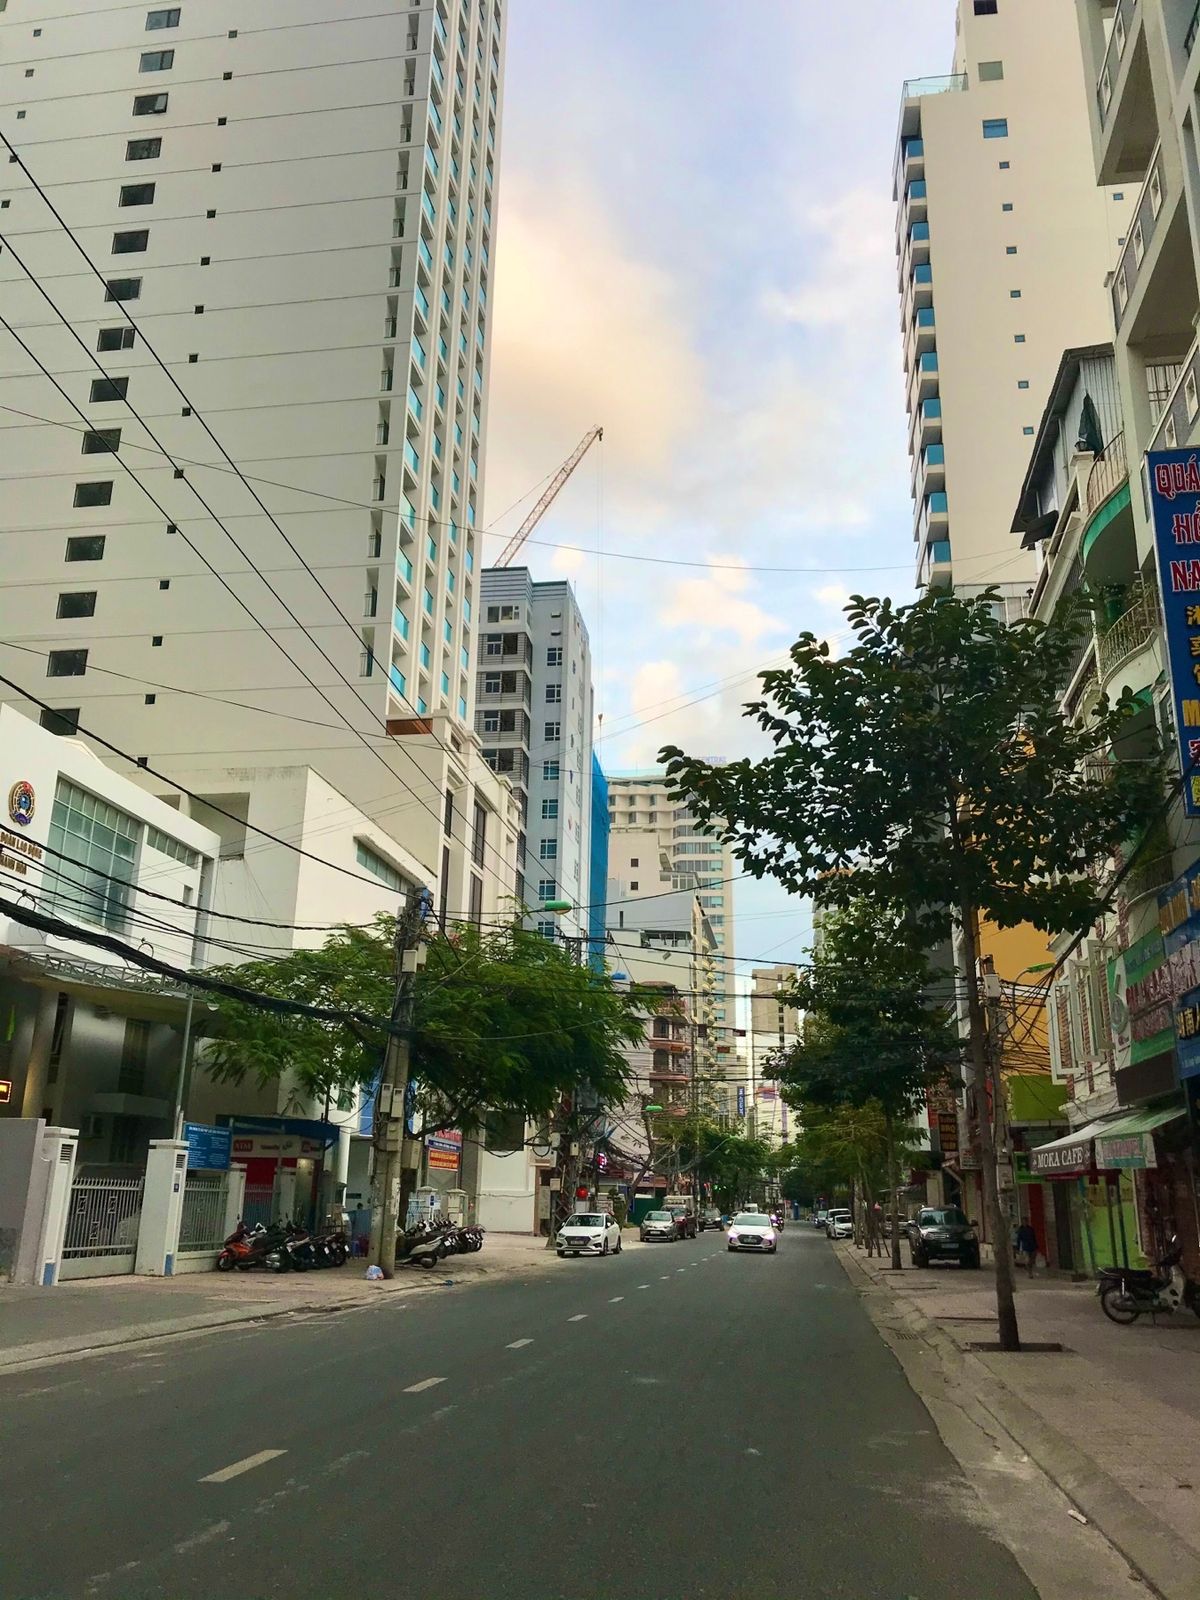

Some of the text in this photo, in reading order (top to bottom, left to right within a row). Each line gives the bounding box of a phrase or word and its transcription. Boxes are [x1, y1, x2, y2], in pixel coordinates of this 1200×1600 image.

[234, 1141, 251, 1150] ATM
[1037, 1150, 1060, 1168] MOKA
[1061, 1147, 1083, 1166] CAFE
